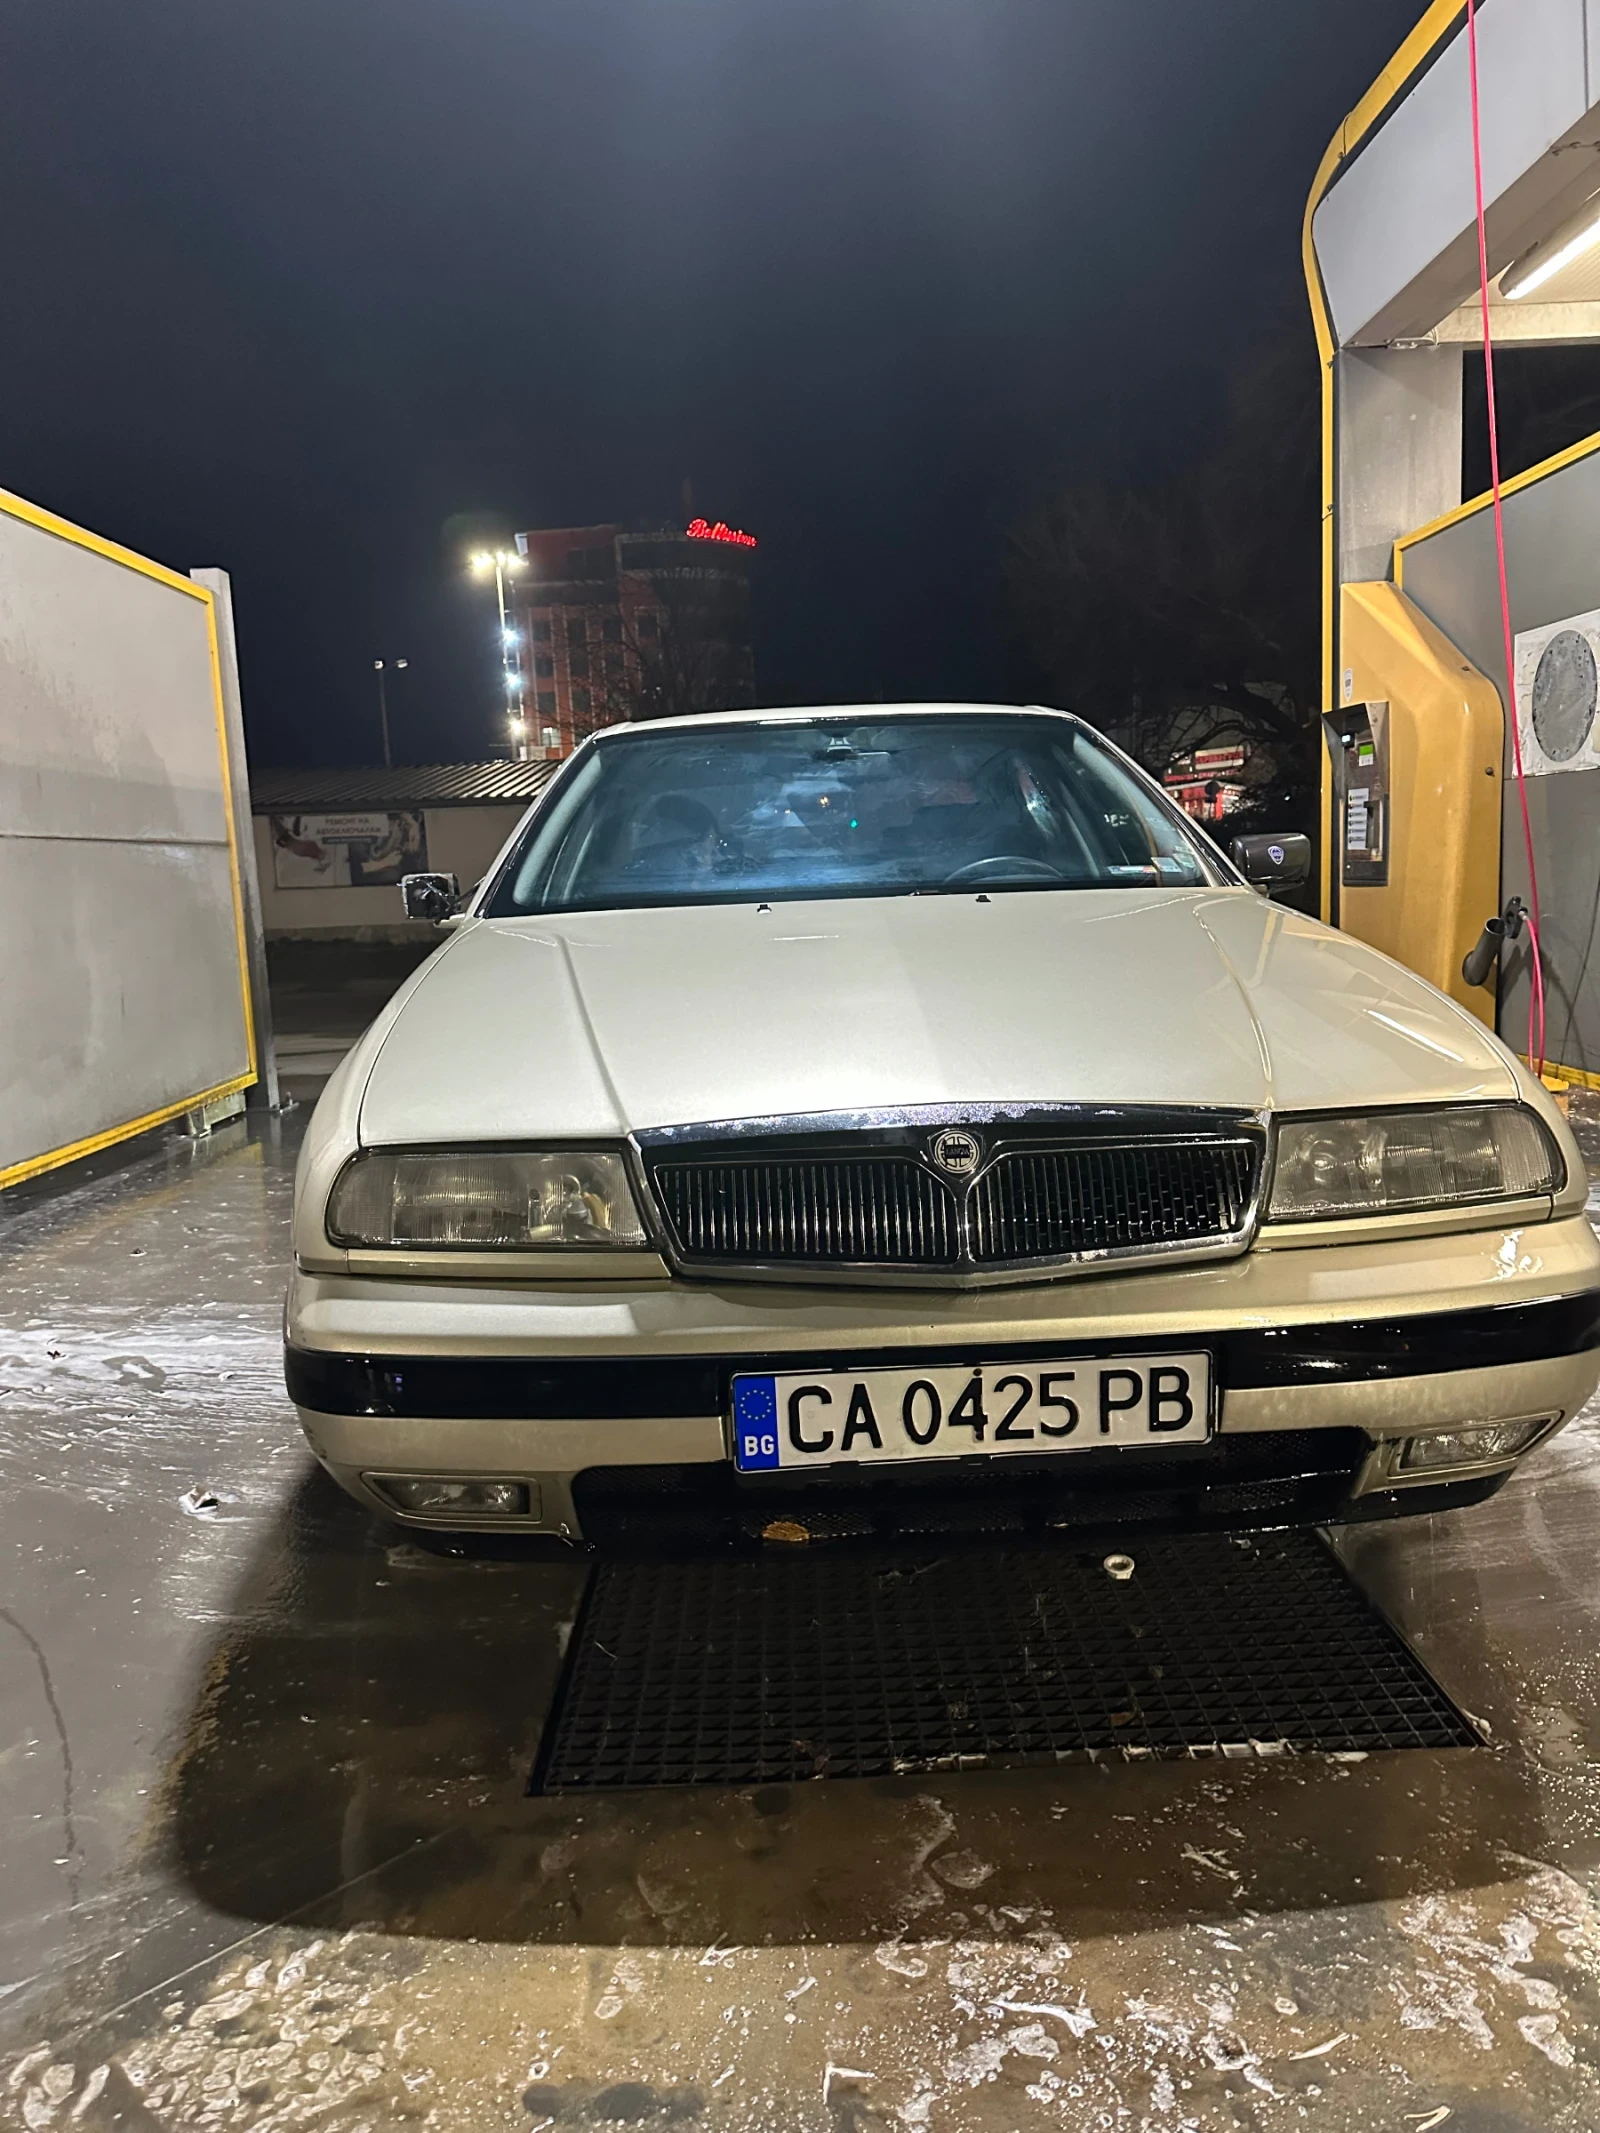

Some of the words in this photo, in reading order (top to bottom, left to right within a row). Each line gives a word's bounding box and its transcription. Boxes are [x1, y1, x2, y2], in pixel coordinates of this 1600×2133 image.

[787, 1382, 883, 1453] CA
[902, 1370, 1079, 1445] 0425
[1098, 1366, 1194, 1435] PB
[744, 1435, 775, 1457] BG
